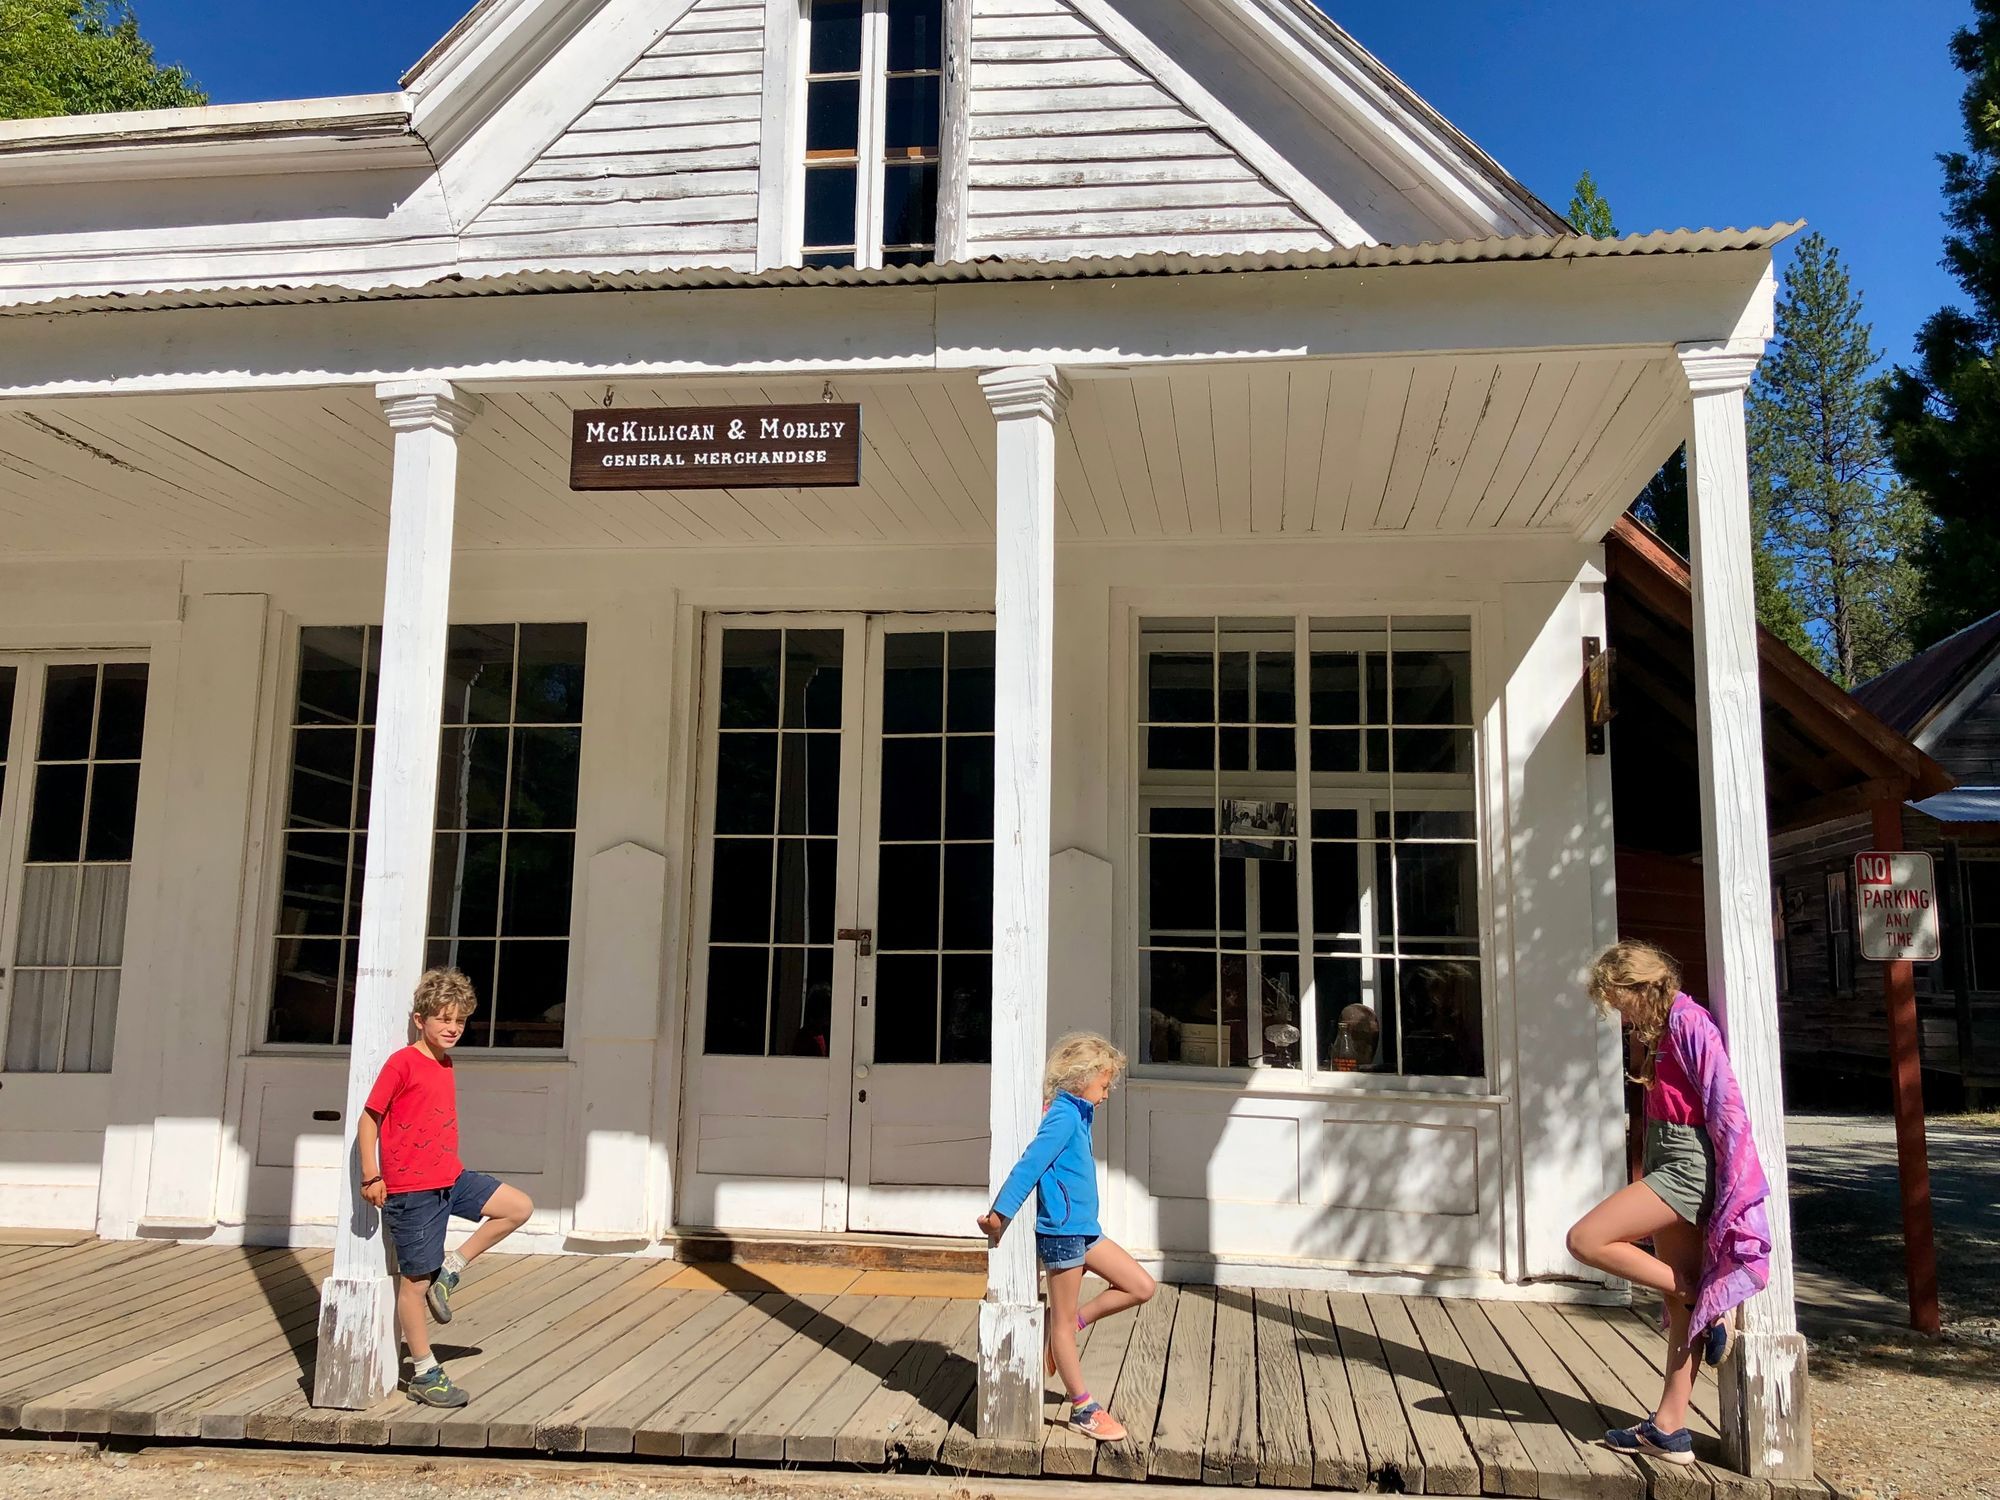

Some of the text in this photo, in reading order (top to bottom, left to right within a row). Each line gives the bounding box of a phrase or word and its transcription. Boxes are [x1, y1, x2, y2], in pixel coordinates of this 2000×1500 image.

[728, 419, 746, 440] &
[602, 451, 827, 467] GENERAL MERCHANDISE
[1861, 857, 1887, 880] NO
[1863, 889, 1929, 909] PARKING
[1885, 913, 1911, 928] ANY
[1886, 932, 1914, 947] TIME
